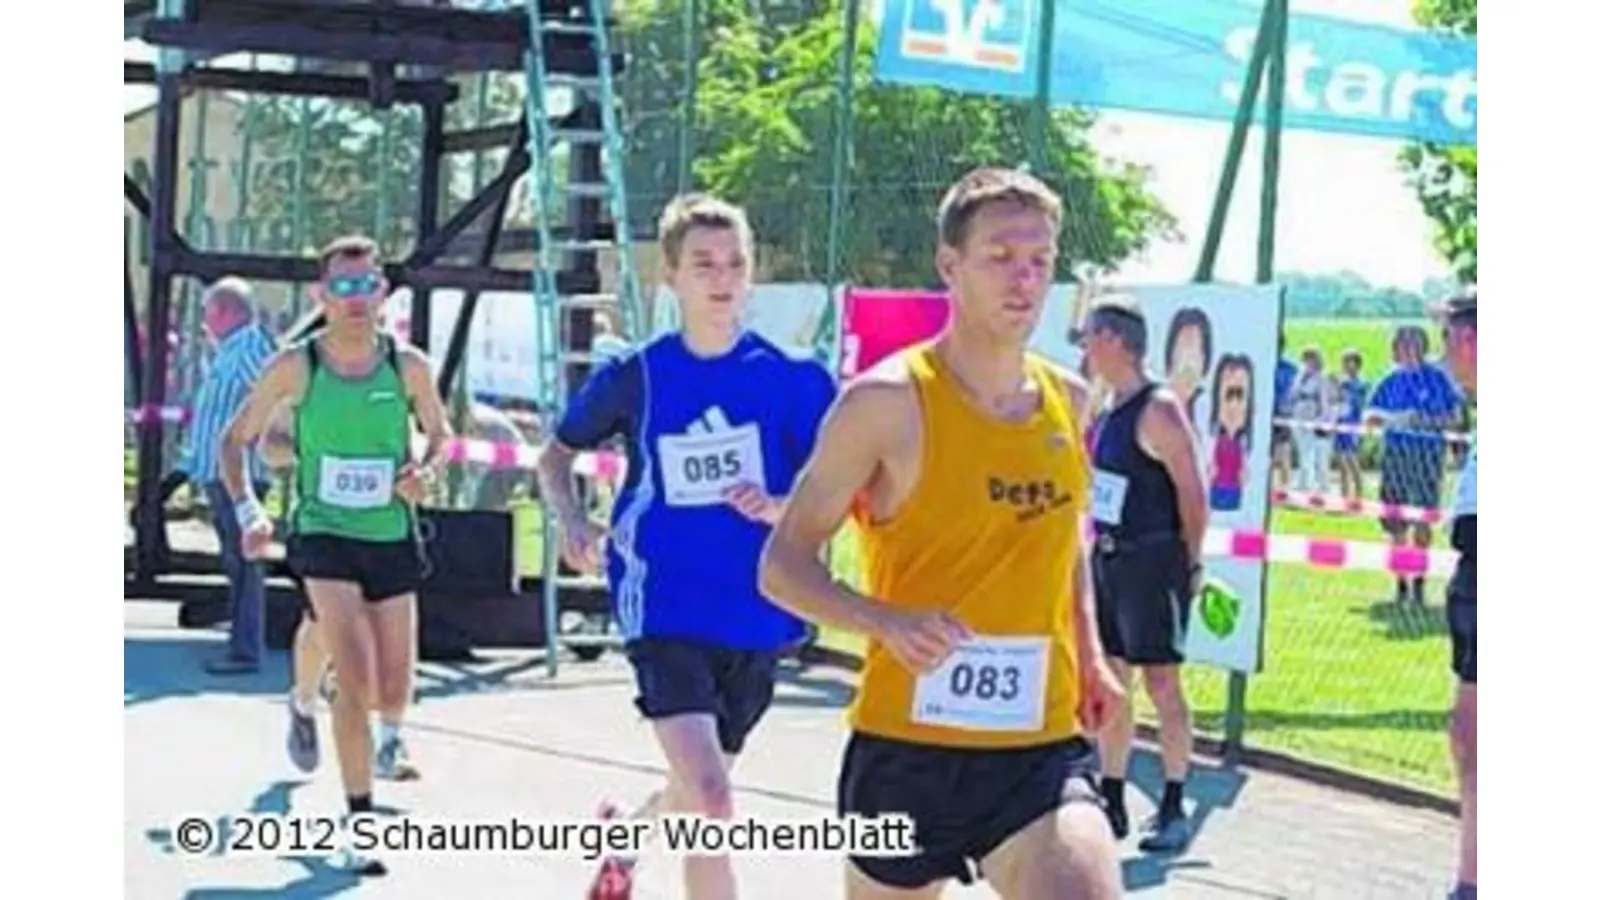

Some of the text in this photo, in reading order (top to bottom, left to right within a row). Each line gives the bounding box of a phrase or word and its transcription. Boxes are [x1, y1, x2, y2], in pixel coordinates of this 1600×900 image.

[1219, 27, 1477, 129] Start
[683, 449, 741, 483] 085
[950, 663, 1021, 701] 083
